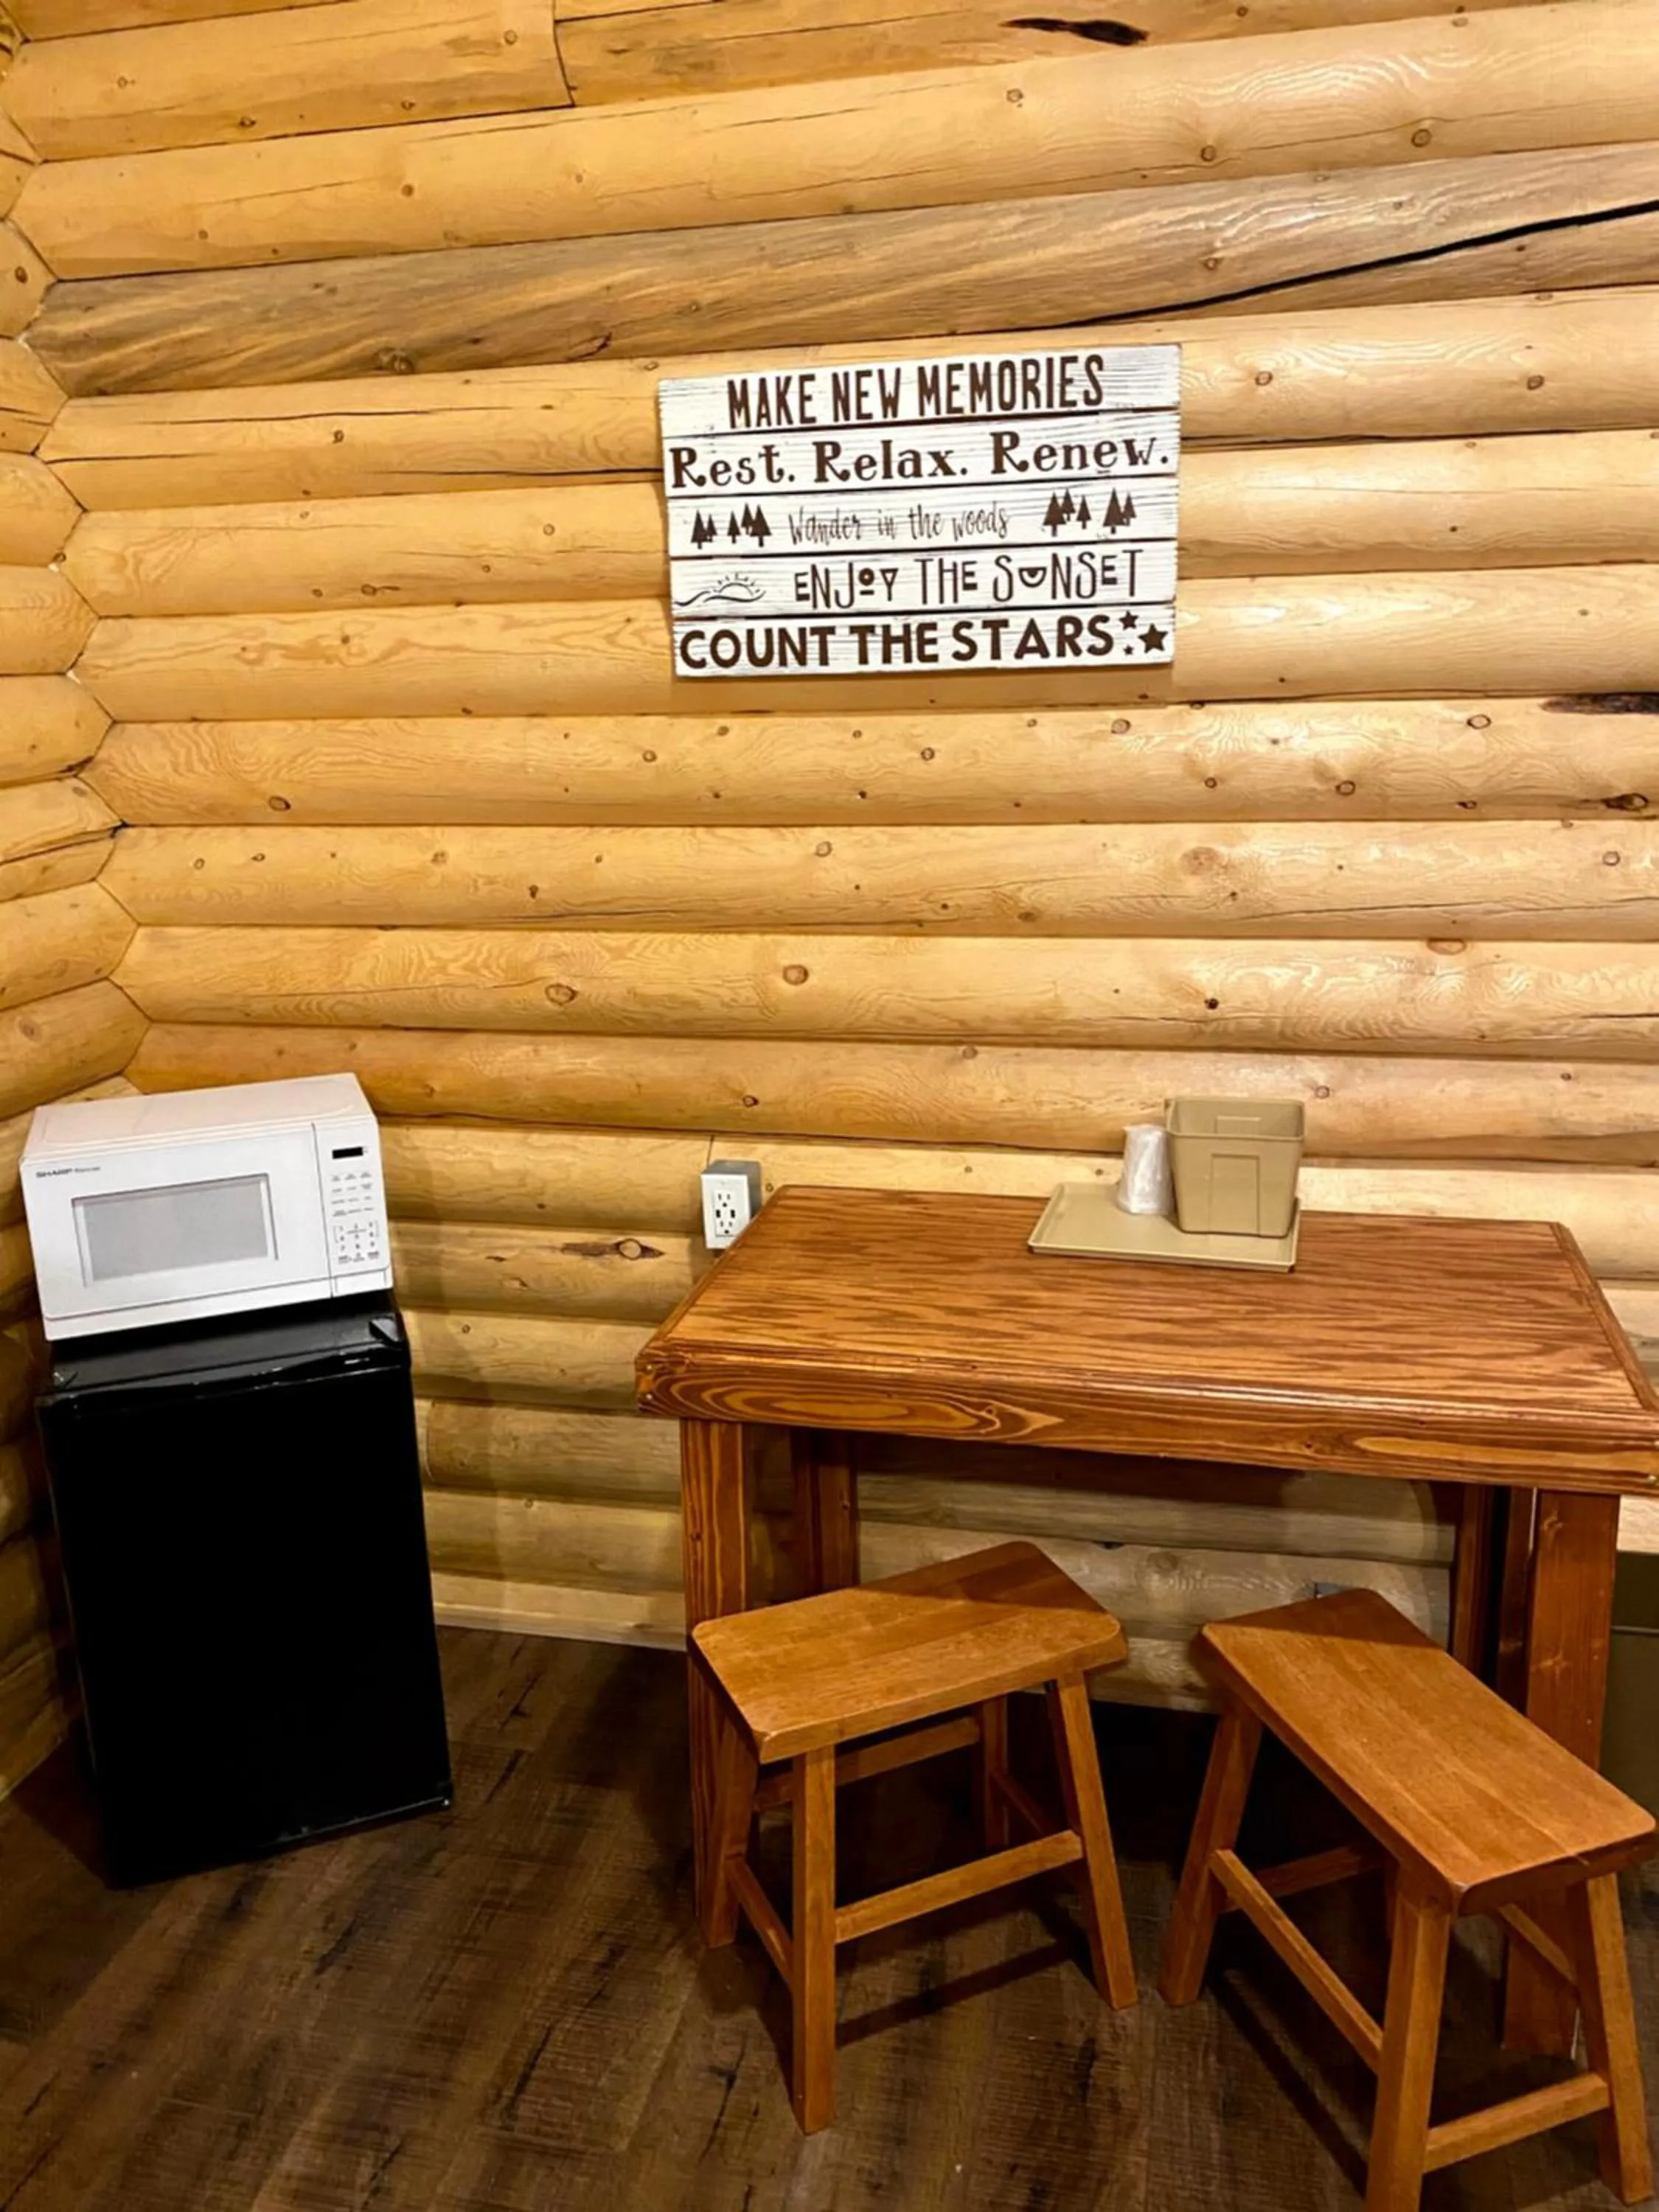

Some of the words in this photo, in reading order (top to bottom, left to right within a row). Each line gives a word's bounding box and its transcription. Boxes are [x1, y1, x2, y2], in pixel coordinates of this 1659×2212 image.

[727, 374, 817, 429] MAKE
[831, 367, 901, 422] NEW
[917, 354, 1105, 416] MEMORIES
[669, 444, 796, 489] Rest.
[811, 439, 968, 484] Relax.
[990, 431, 1169, 474] Renew.
[787, 505, 862, 545] Wander
[877, 510, 897, 538] in
[908, 503, 945, 540] the
[951, 500, 1009, 540] woods
[793, 563, 899, 610] ENJOY
[914, 557, 978, 605] THE
[992, 549, 1144, 603] SUNSET
[679, 625, 836, 669] COUNT
[848, 622, 939, 665] THE
[951, 614, 1114, 662] STARS
